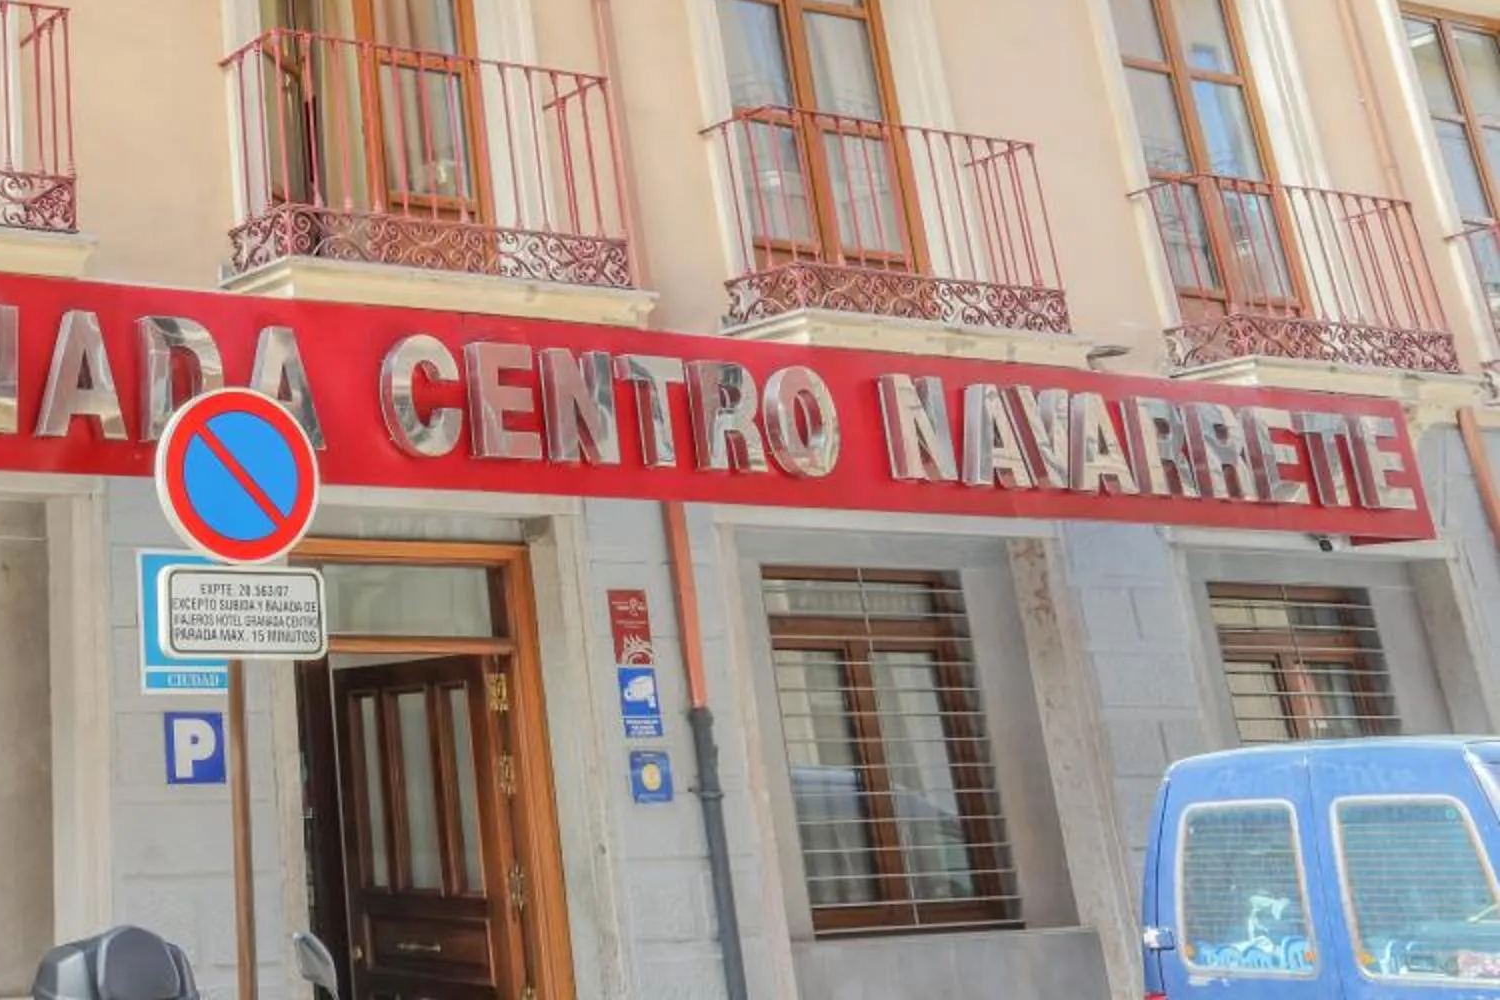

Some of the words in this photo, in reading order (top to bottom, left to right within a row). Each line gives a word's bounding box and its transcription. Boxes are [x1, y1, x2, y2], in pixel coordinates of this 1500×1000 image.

[380, 334, 841, 478] CENTRO
[877, 373, 1418, 510] NAVARRETE
[172, 598, 217, 611] EXCEPTO
[219, 599, 255, 611] SUBIDA
[256, 600, 263, 612] Y
[265, 600, 302, 612] BAJADA
[304, 601, 317, 613] DE
[215, 614, 242, 626] HOTEL
[243, 615, 284, 627] GRANADA
[285, 616, 318, 628] CENTRO
[174, 628, 218, 641] PARADA
[251, 630, 266, 642] 15
[267, 630, 317, 643] MINUTOS
[173, 719, 217, 779] P
